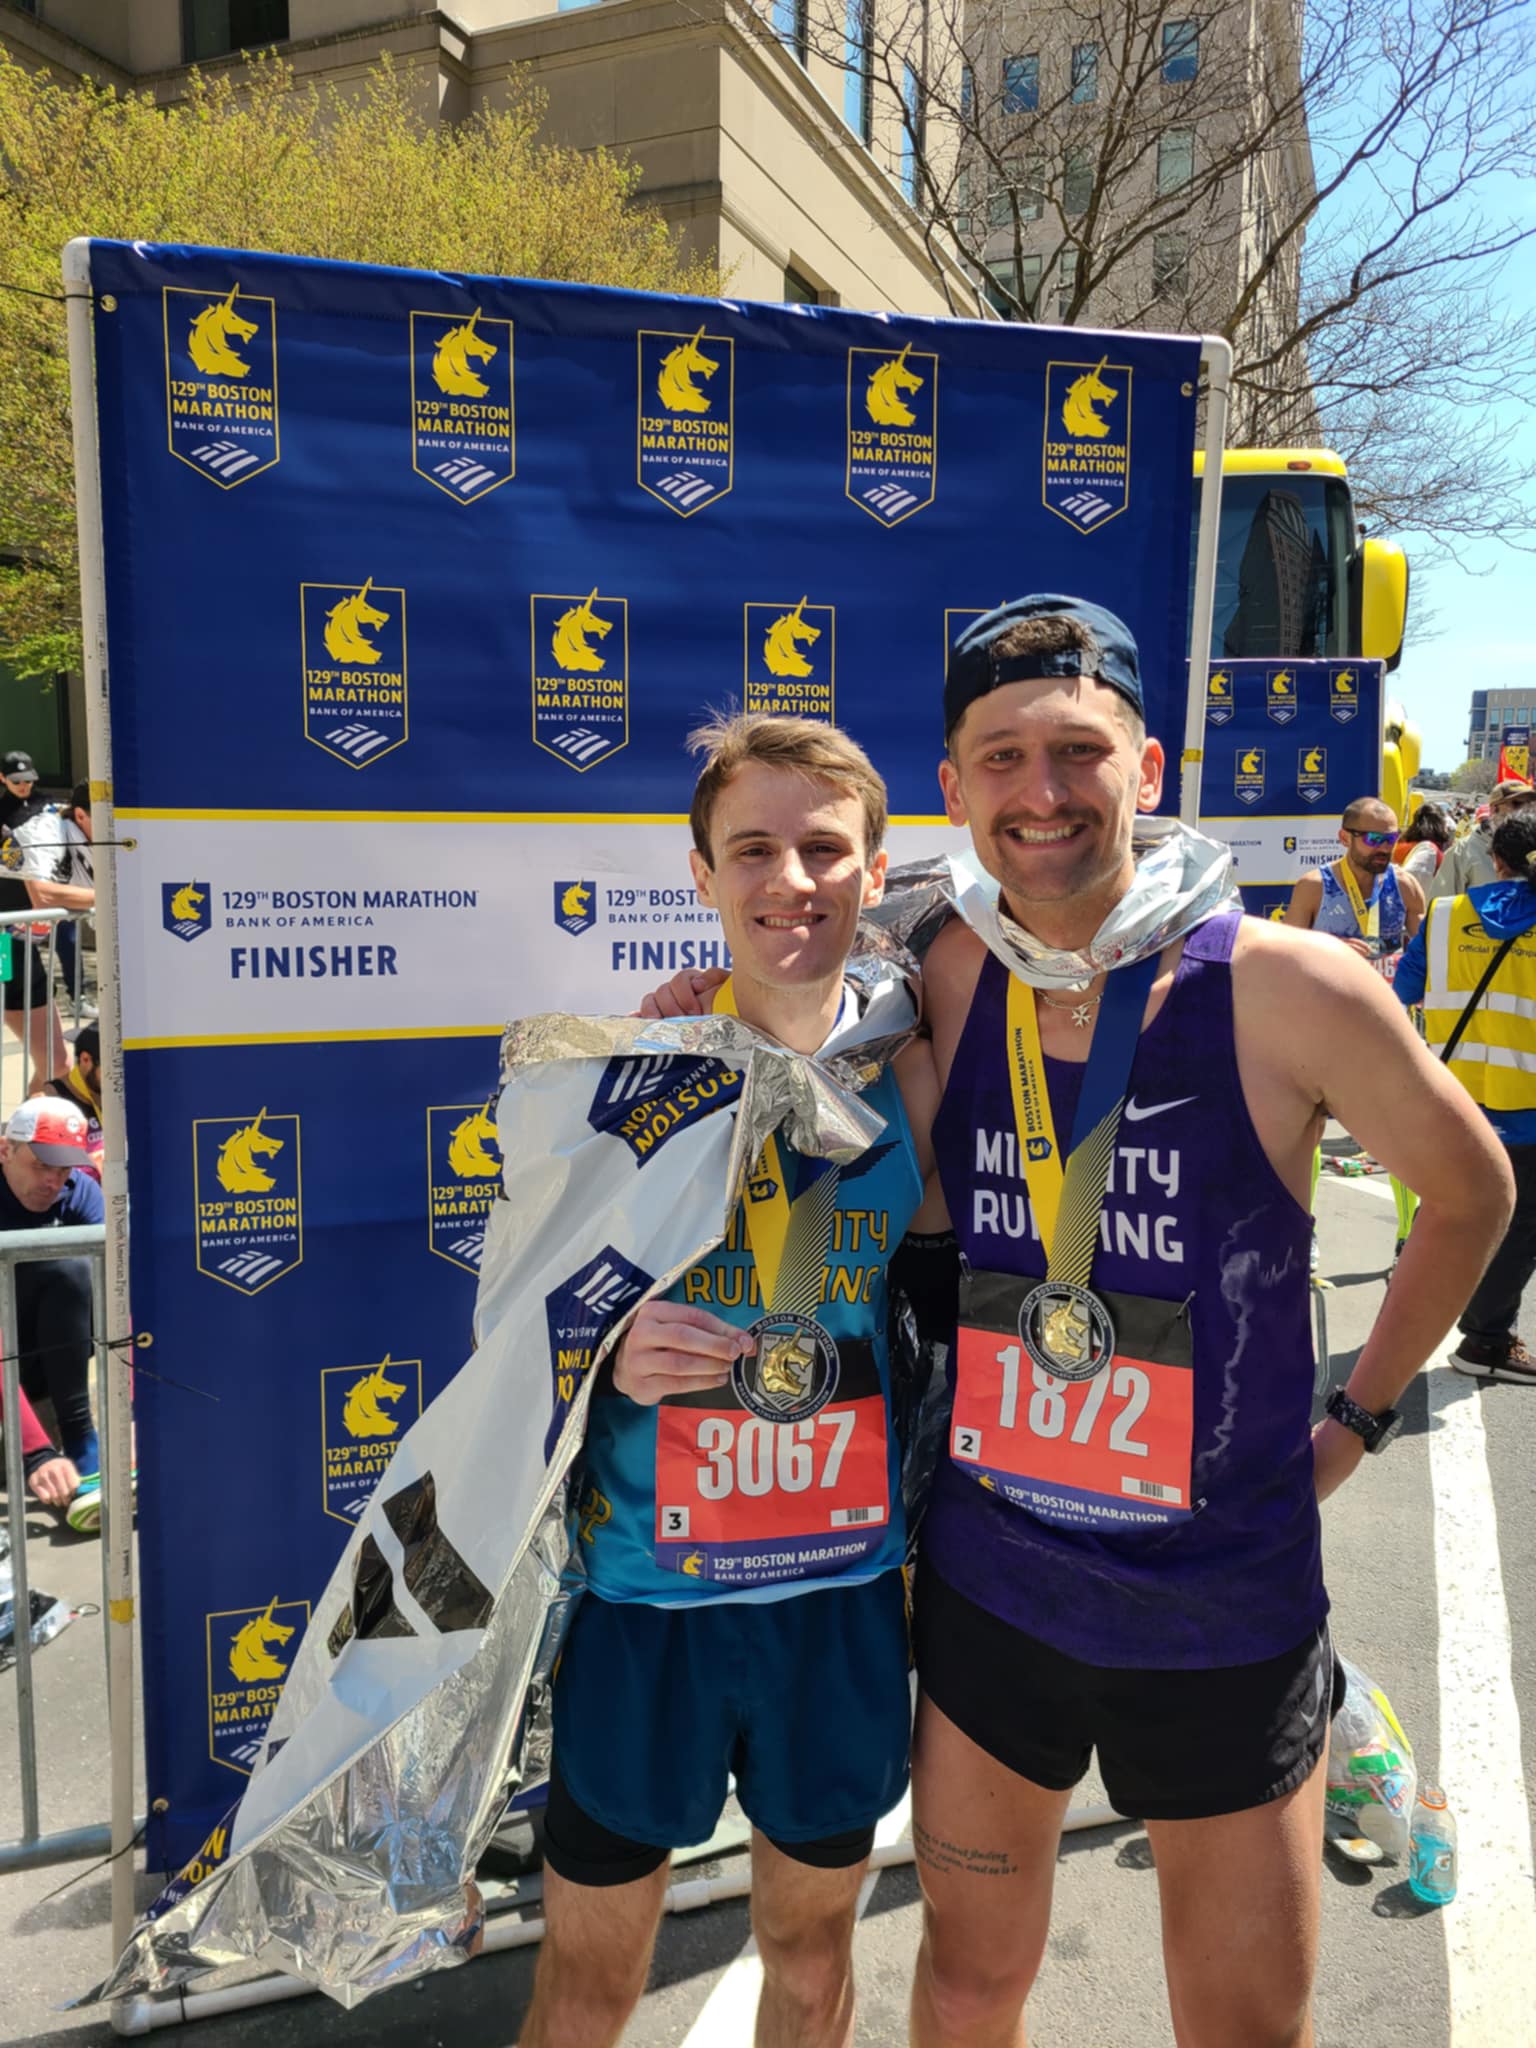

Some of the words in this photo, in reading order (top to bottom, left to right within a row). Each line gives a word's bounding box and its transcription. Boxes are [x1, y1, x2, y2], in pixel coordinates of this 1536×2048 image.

[208, 384, 272, 402] BOSTON
[173, 399, 272, 420] MARATHON
[450, 403, 509, 420] BOSTON
[174, 421, 204, 430] BANK
[207, 424, 220, 432] OF
[224, 426, 273, 436] AMERICA
[418, 417, 509, 437] MARATHON
[673, 419, 728, 436] BOSTON
[418, 439, 446, 448] BANK
[464, 443, 509, 452] AMERICA
[643, 434, 728, 453] MARATHON
[881, 432, 931, 448] BOSTON
[852, 447, 931, 465] MARATHON
[1075, 444, 1125, 458] BOSTON
[643, 455, 669, 463] BANK
[685, 457, 727, 466] AMERICA
[1047, 458, 1125, 474] MARATHON
[852, 467, 876, 475] BANK
[891, 469, 930, 478] AMERICA
[1047, 477, 1071, 485] BANK
[1086, 478, 1124, 487] AMERICA
[342, 671, 401, 687] BOSTON
[568, 678, 623, 693] BOSTON
[309, 687, 402, 703] MARATHON
[777, 683, 829, 698] BOSTON
[537, 694, 623, 709] MARATHON
[749, 698, 829, 712] MARATHON
[340, 708, 353, 716] OF
[356, 709, 402, 717] AMERICA
[538, 713, 564, 721] BANK
[272, 890, 356, 910] BOSTON
[363, 890, 477, 909] MARATHON
[649, 889, 697, 906] BOST
[226, 917, 271, 928] BANK
[276, 916, 297, 927] OF
[301, 916, 374, 927] AMERICA
[608, 913, 648, 923] BANK
[652, 913, 671, 923] OF
[674, 913, 719, 923] AMERI
[230, 945, 398, 979] FINISHER
[612, 940, 732, 971] FINISHE
[1015, 1028, 1028, 1086] MARATHON
[1022, 1089, 1035, 1132] BOSTON
[464, 1183, 500, 1198] BOST
[235, 1197, 296, 1215] BOSTON
[434, 1200, 493, 1216] MARAT
[201, 1214, 296, 1233] MARATHON
[435, 1221, 460, 1229] BANK
[202, 1238, 231, 1247] BANK
[233, 1237, 247, 1245] OF
[250, 1234, 296, 1243] AMERICA
[755, 1315, 794, 1330] BOSTON
[796, 1316, 835, 1357] MARATHON
[995, 1344, 1151, 1457] 1872
[360, 1441, 397, 1458] BOST
[961, 1434, 974, 1453] 2
[696, 1410, 857, 1500] 3067
[328, 1459, 390, 1477] MARAT
[329, 1481, 356, 1490] BANK
[1031, 1491, 1086, 1514] BOSTON
[1088, 1504, 1169, 1524] MARATHON
[1036, 1506, 1049, 1516] OF
[1050, 1511, 1098, 1525] AMERICA
[668, 1512, 682, 1531] 3
[743, 1552, 796, 1569] BOSTON
[797, 1541, 867, 1563] MARATHON
[714, 1571, 742, 1581] BANK
[745, 1571, 758, 1580] OF
[760, 1567, 805, 1580] AMERICA
[247, 1685, 284, 1702] BOST
[215, 1702, 278, 1723] MARAT
[215, 1727, 242, 1736] BANK
